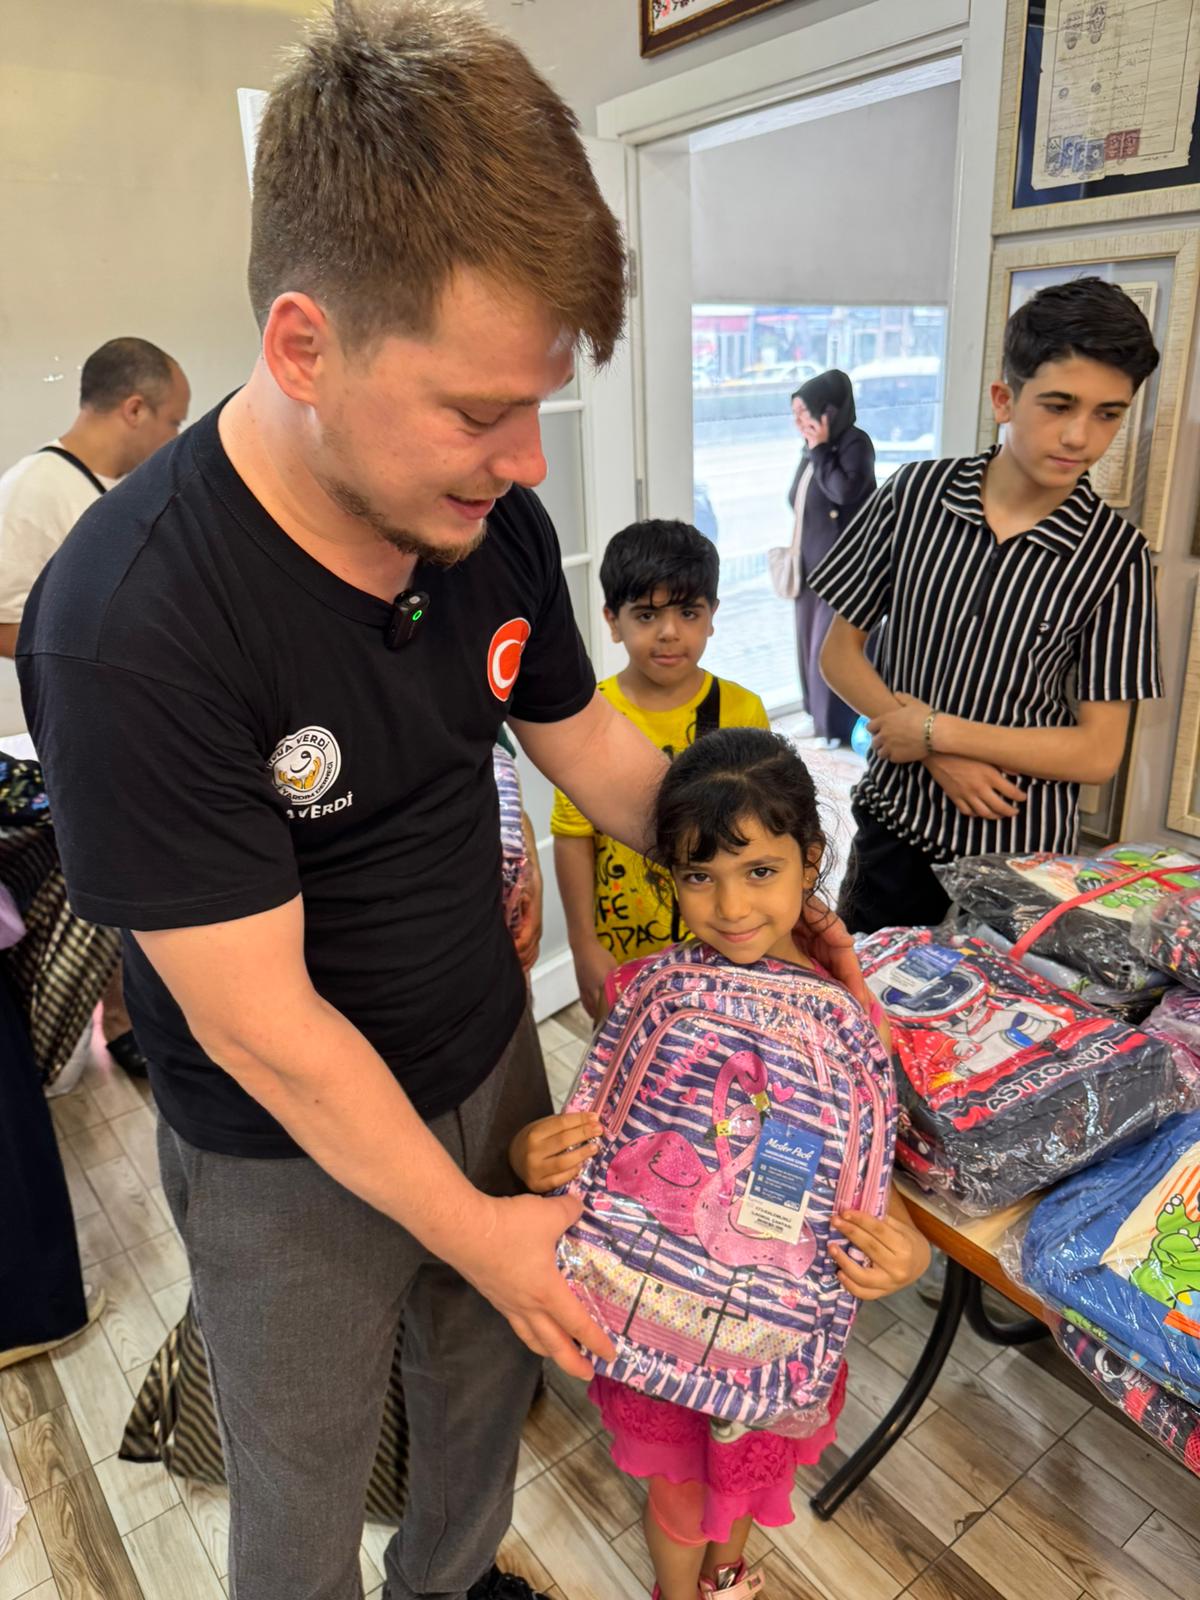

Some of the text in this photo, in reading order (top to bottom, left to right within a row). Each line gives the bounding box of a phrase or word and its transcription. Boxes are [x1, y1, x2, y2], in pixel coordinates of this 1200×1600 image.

[297, 734, 330, 750] VERDİ
[298, 791, 353, 819] VERDİ
[986, 1039, 1120, 1112] ASTRONAUT
